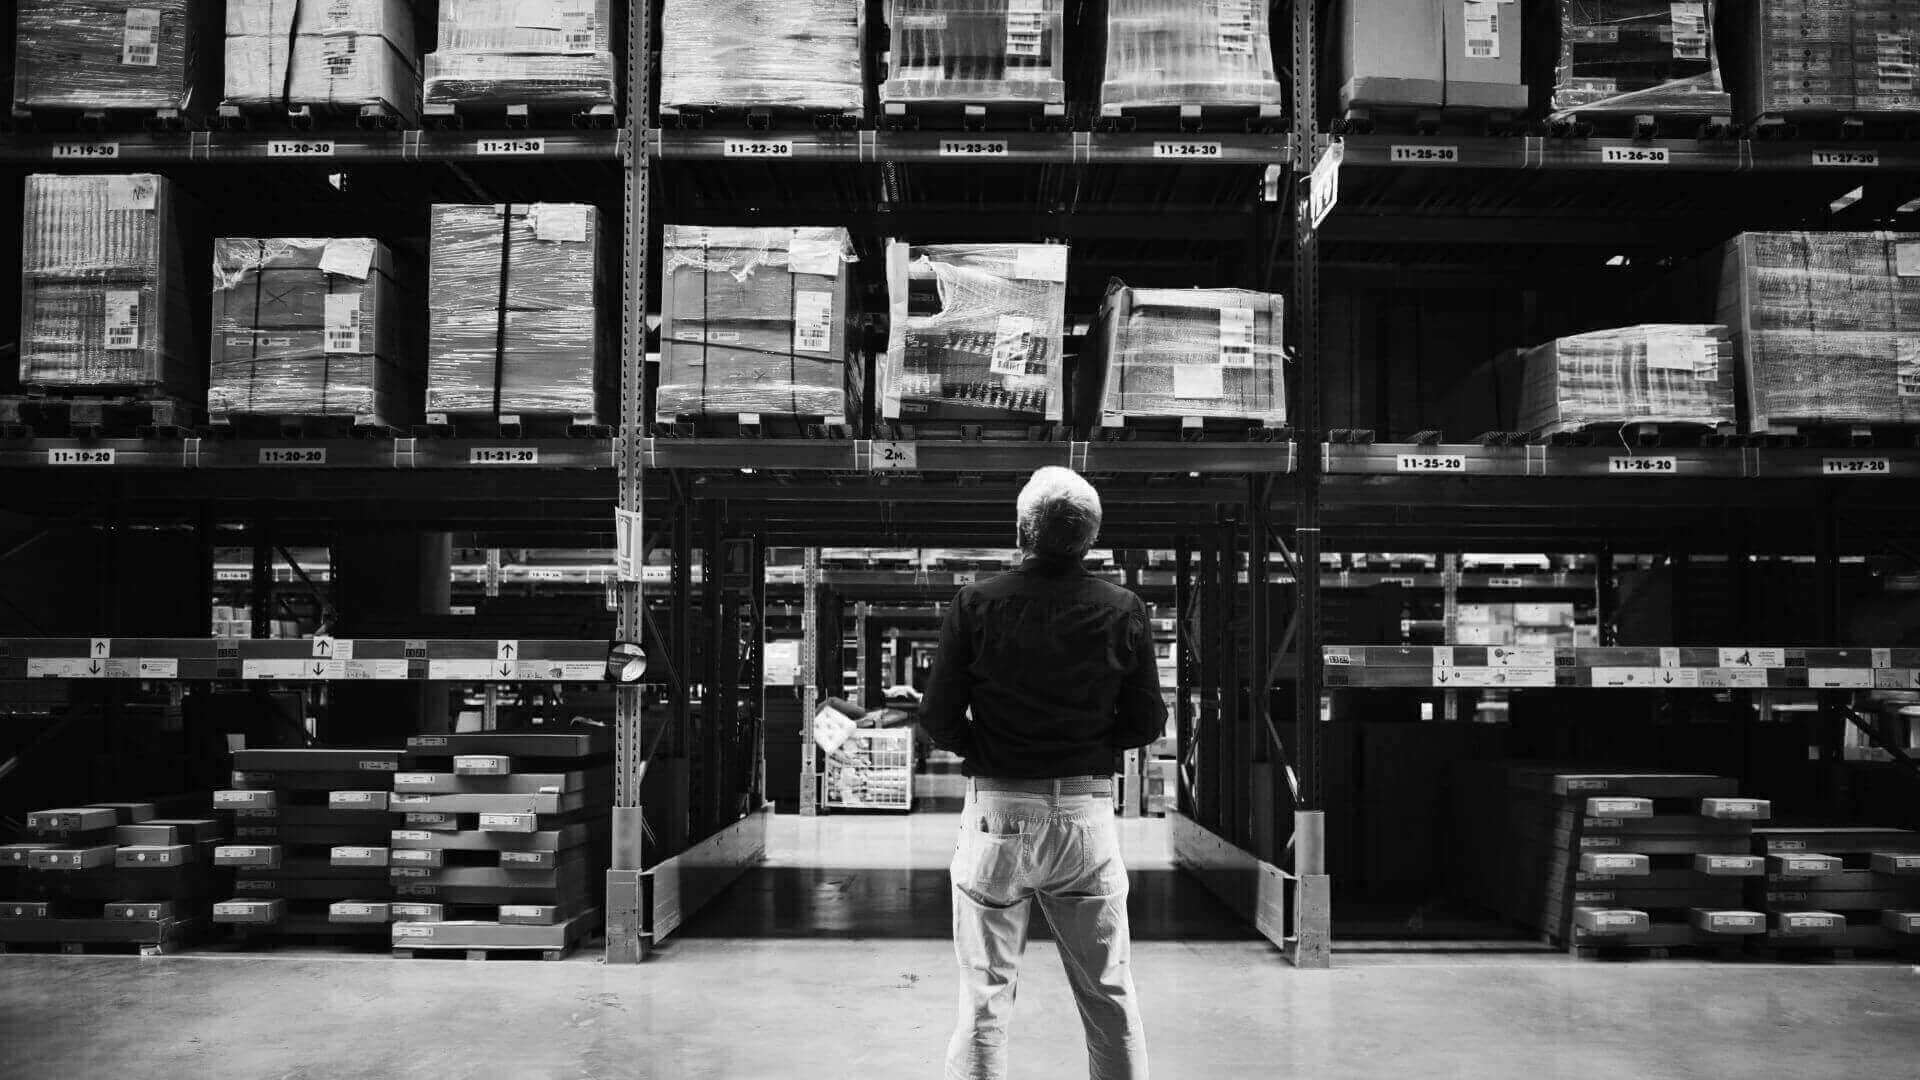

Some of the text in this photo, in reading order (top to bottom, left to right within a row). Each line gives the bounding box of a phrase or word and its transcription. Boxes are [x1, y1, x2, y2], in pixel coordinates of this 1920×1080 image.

[59, 146, 114, 155] 11-19-30
[274, 144, 330, 153] 11-20-30
[483, 142, 540, 151] 11-21-30
[730, 144, 788, 153] 11-22-30
[946, 144, 1003, 153] 11-23-30
[1160, 145, 1217, 154] 11-24-30
[1396, 150, 1453, 158] 11-25-30
[1608, 151, 1664, 161] 11-26-30
[1817, 154, 1874, 163] 11-27-30
[54, 452, 110, 462] 11-19-20
[265, 451, 321, 461] 11-20-20
[476, 451, 533, 461] 11-21-20
[1403, 459, 1460, 468] 11-25-20
[1614, 460, 1671, 469] 11-26-20
[1828, 462, 1885, 471] 11-27-20
